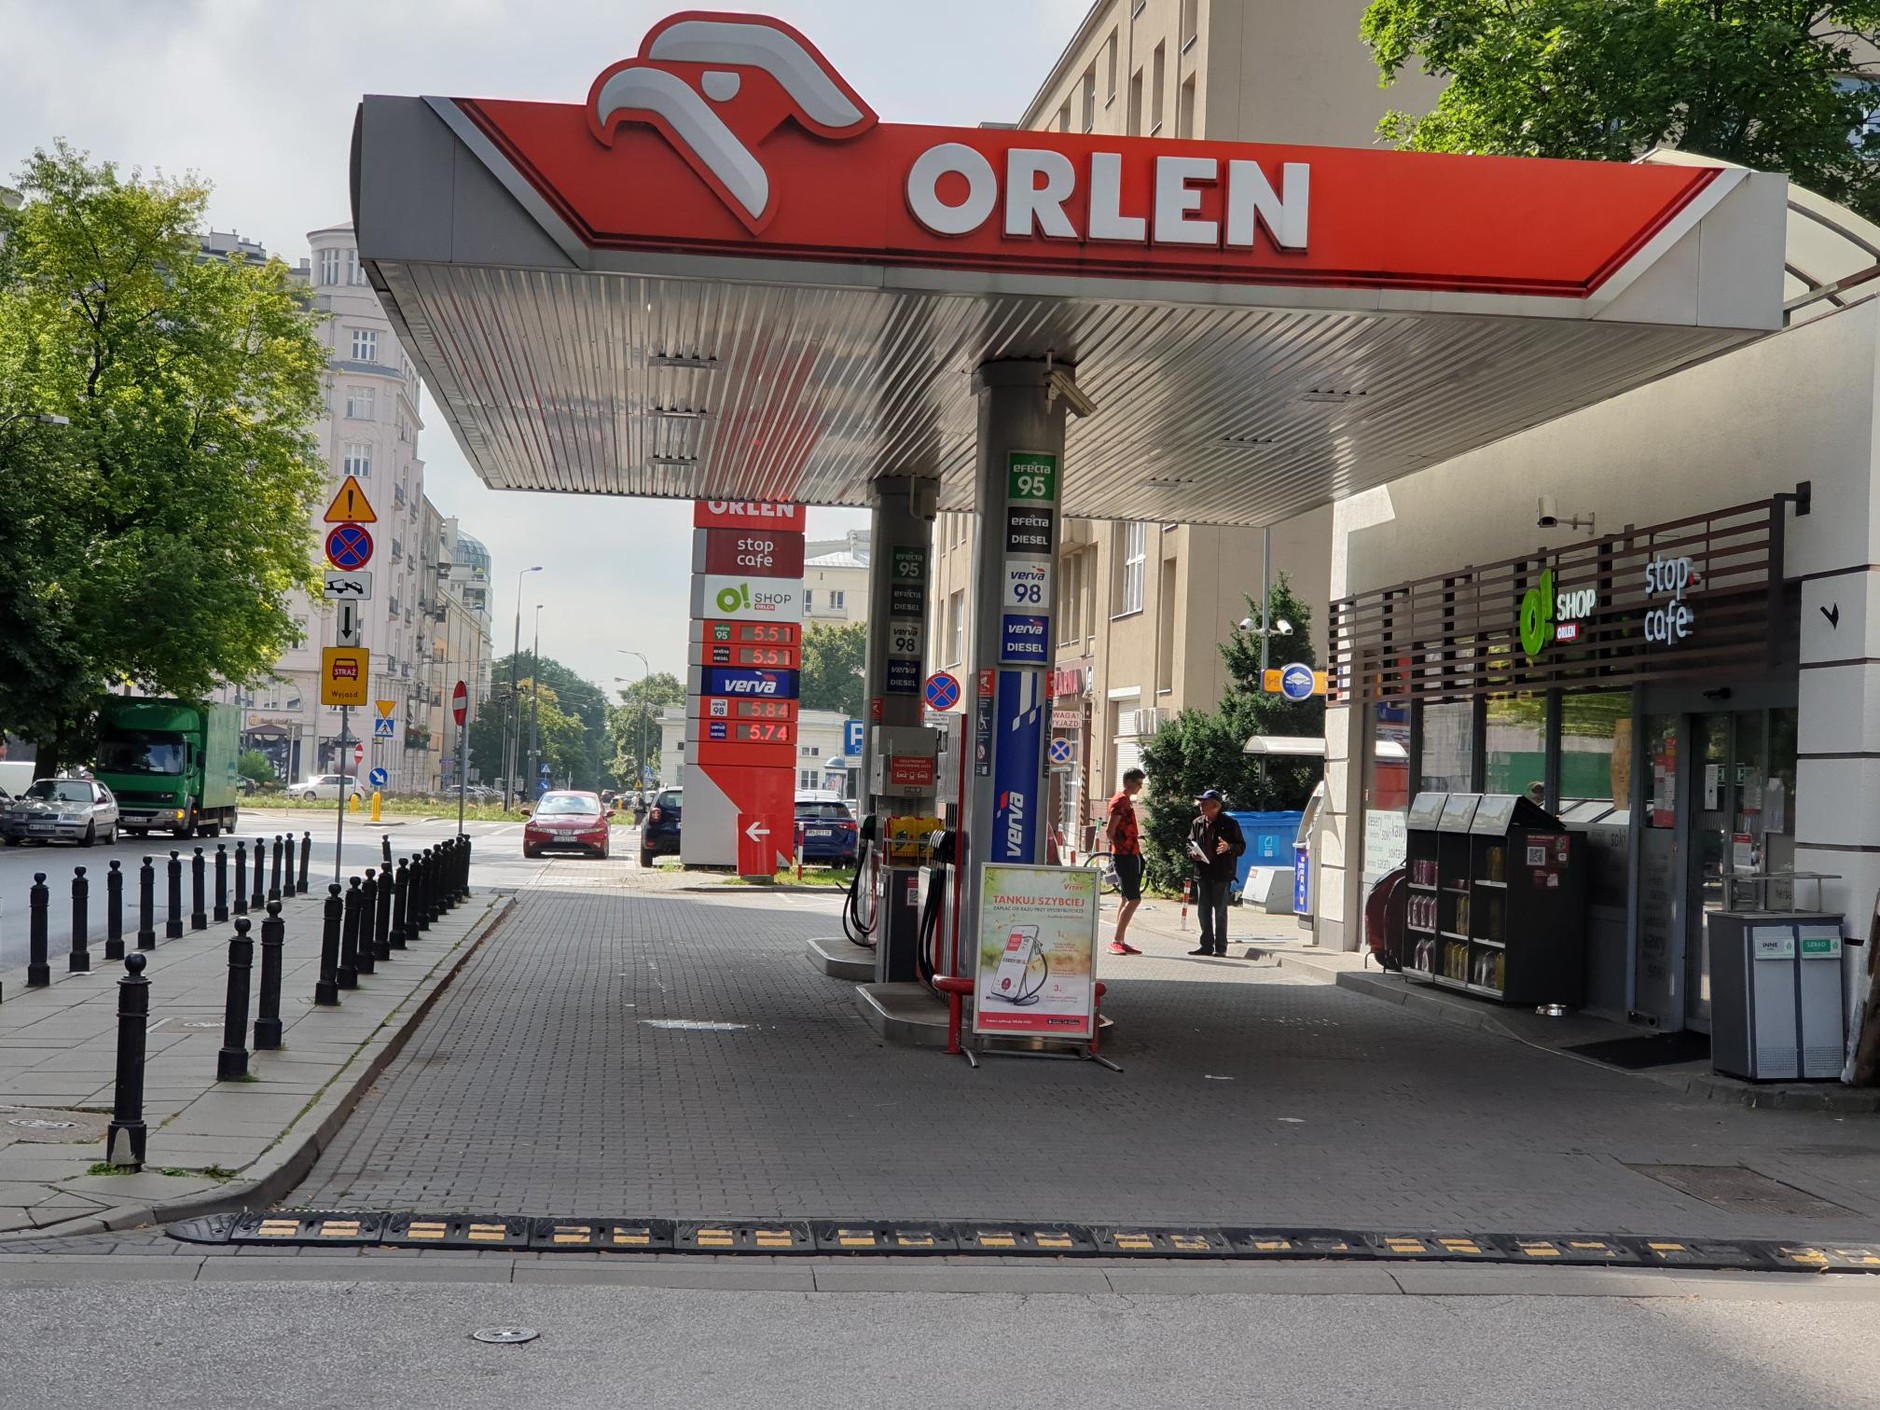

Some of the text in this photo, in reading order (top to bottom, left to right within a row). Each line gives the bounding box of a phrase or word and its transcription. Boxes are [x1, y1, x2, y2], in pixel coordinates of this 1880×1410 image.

[906, 142, 1311, 249] ORLEN
[1012, 462, 1051, 475] efecta
[1017, 475, 1046, 497] 95
[707, 500, 794, 519] ORLEN
[1011, 515, 1049, 528] efecta
[737, 537, 774, 554] stop
[1011, 534, 1048, 546] DIESEL
[737, 553, 773, 568] cafe
[899, 562, 920, 578] 95
[1010, 569, 1046, 582] verva
[755, 591, 792, 605] SHOP
[1013, 582, 1042, 604] 98
[894, 602, 920, 611] DIESEL
[1556, 588, 1596, 622] SHOP
[1008, 623, 1044, 635] verva
[1644, 600, 1688, 645] cafe
[716, 631, 729, 640] 95
[753, 627, 791, 642] 5.51
[892, 626, 919, 637] verva
[1556, 624, 1576, 640] ORLEN
[895, 637, 916, 652] 98
[1007, 642, 1044, 653] DIESEL
[752, 650, 791, 664] 5.51
[724, 677, 777, 694] verva
[331, 690, 358, 699] Wyjazd
[713, 707, 725, 715] 98
[751, 700, 788, 717] 5.84
[749, 724, 788, 741] 5.74
[1006, 790, 1024, 857] verva
[993, 895, 1085, 907] TANKUJ SZYBCIEJ
